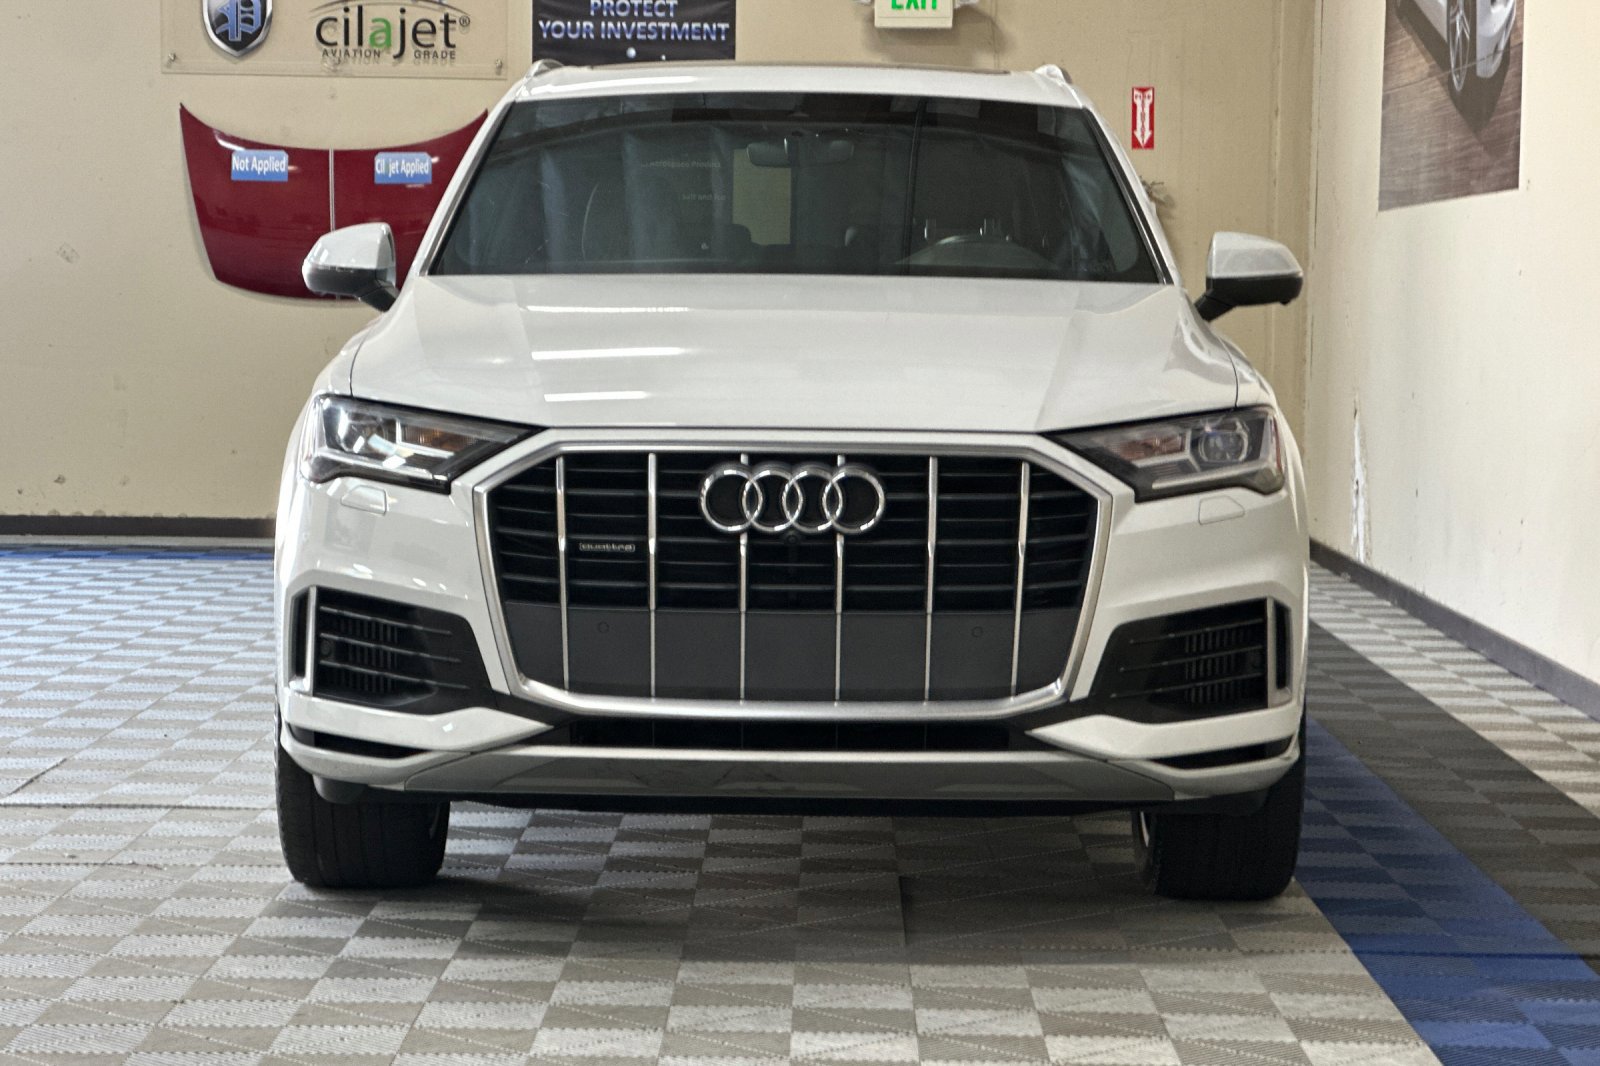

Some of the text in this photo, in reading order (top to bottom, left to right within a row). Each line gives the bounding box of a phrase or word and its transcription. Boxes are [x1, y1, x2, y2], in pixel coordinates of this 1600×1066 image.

[590, 0, 678, 17] PROTECT
[538, 20, 730, 41] YOUR INVESTMENT
[322, 50, 456, 59] AVIATION GRADE
[232, 155, 286, 176] Not Applied
[375, 158, 429, 178] Ciljet Applied
